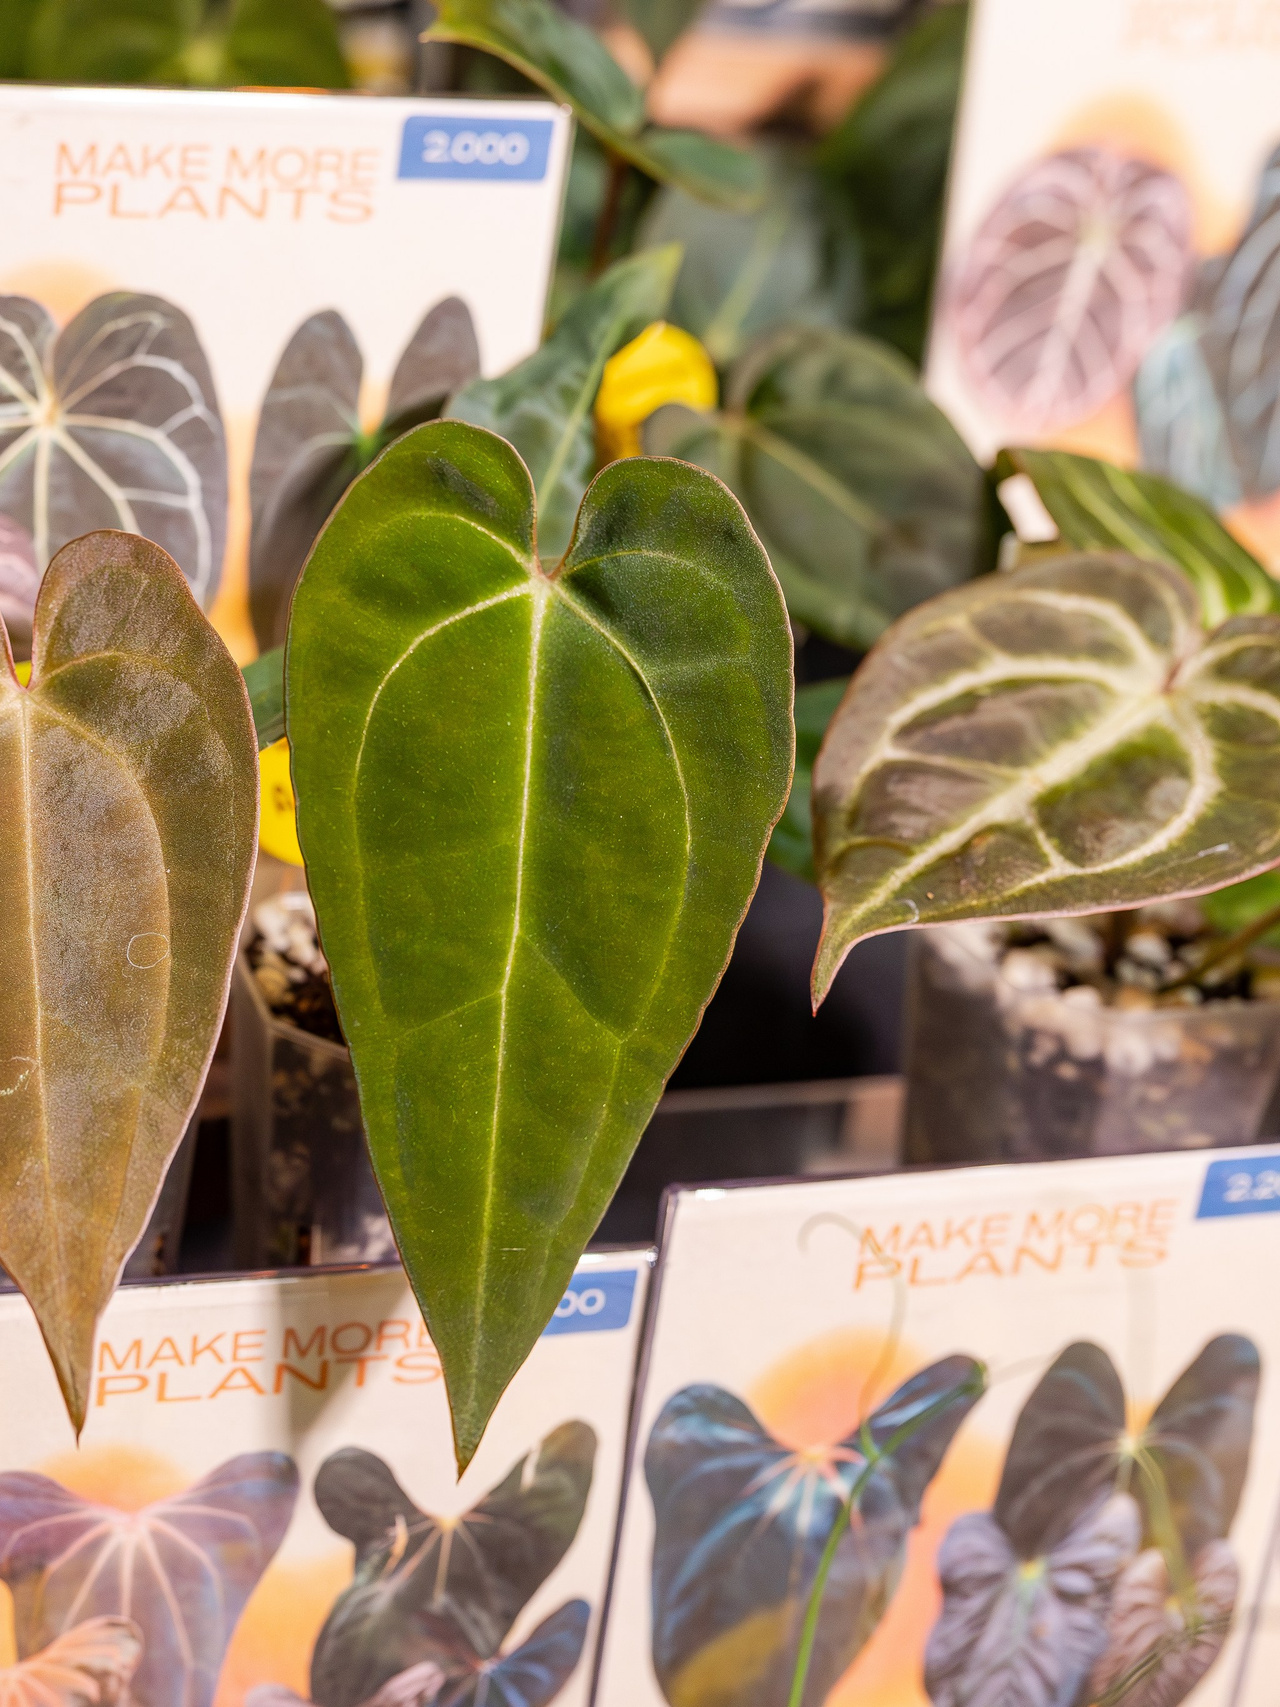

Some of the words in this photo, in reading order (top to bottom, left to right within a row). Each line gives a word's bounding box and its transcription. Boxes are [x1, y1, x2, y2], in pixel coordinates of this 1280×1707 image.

[54, 141, 211, 181] MAKE
[224, 145, 380, 189] MORE
[422, 129, 531, 166] 2.000
[52, 181, 375, 224] PLANTS
[858, 1213, 1011, 1257] MAKE
[1022, 1199, 1179, 1246] MORE
[852, 1240, 1170, 1292] PLANTS
[96, 1328, 268, 1374] MAKE
[95, 1351, 443, 1408] PLANTS
